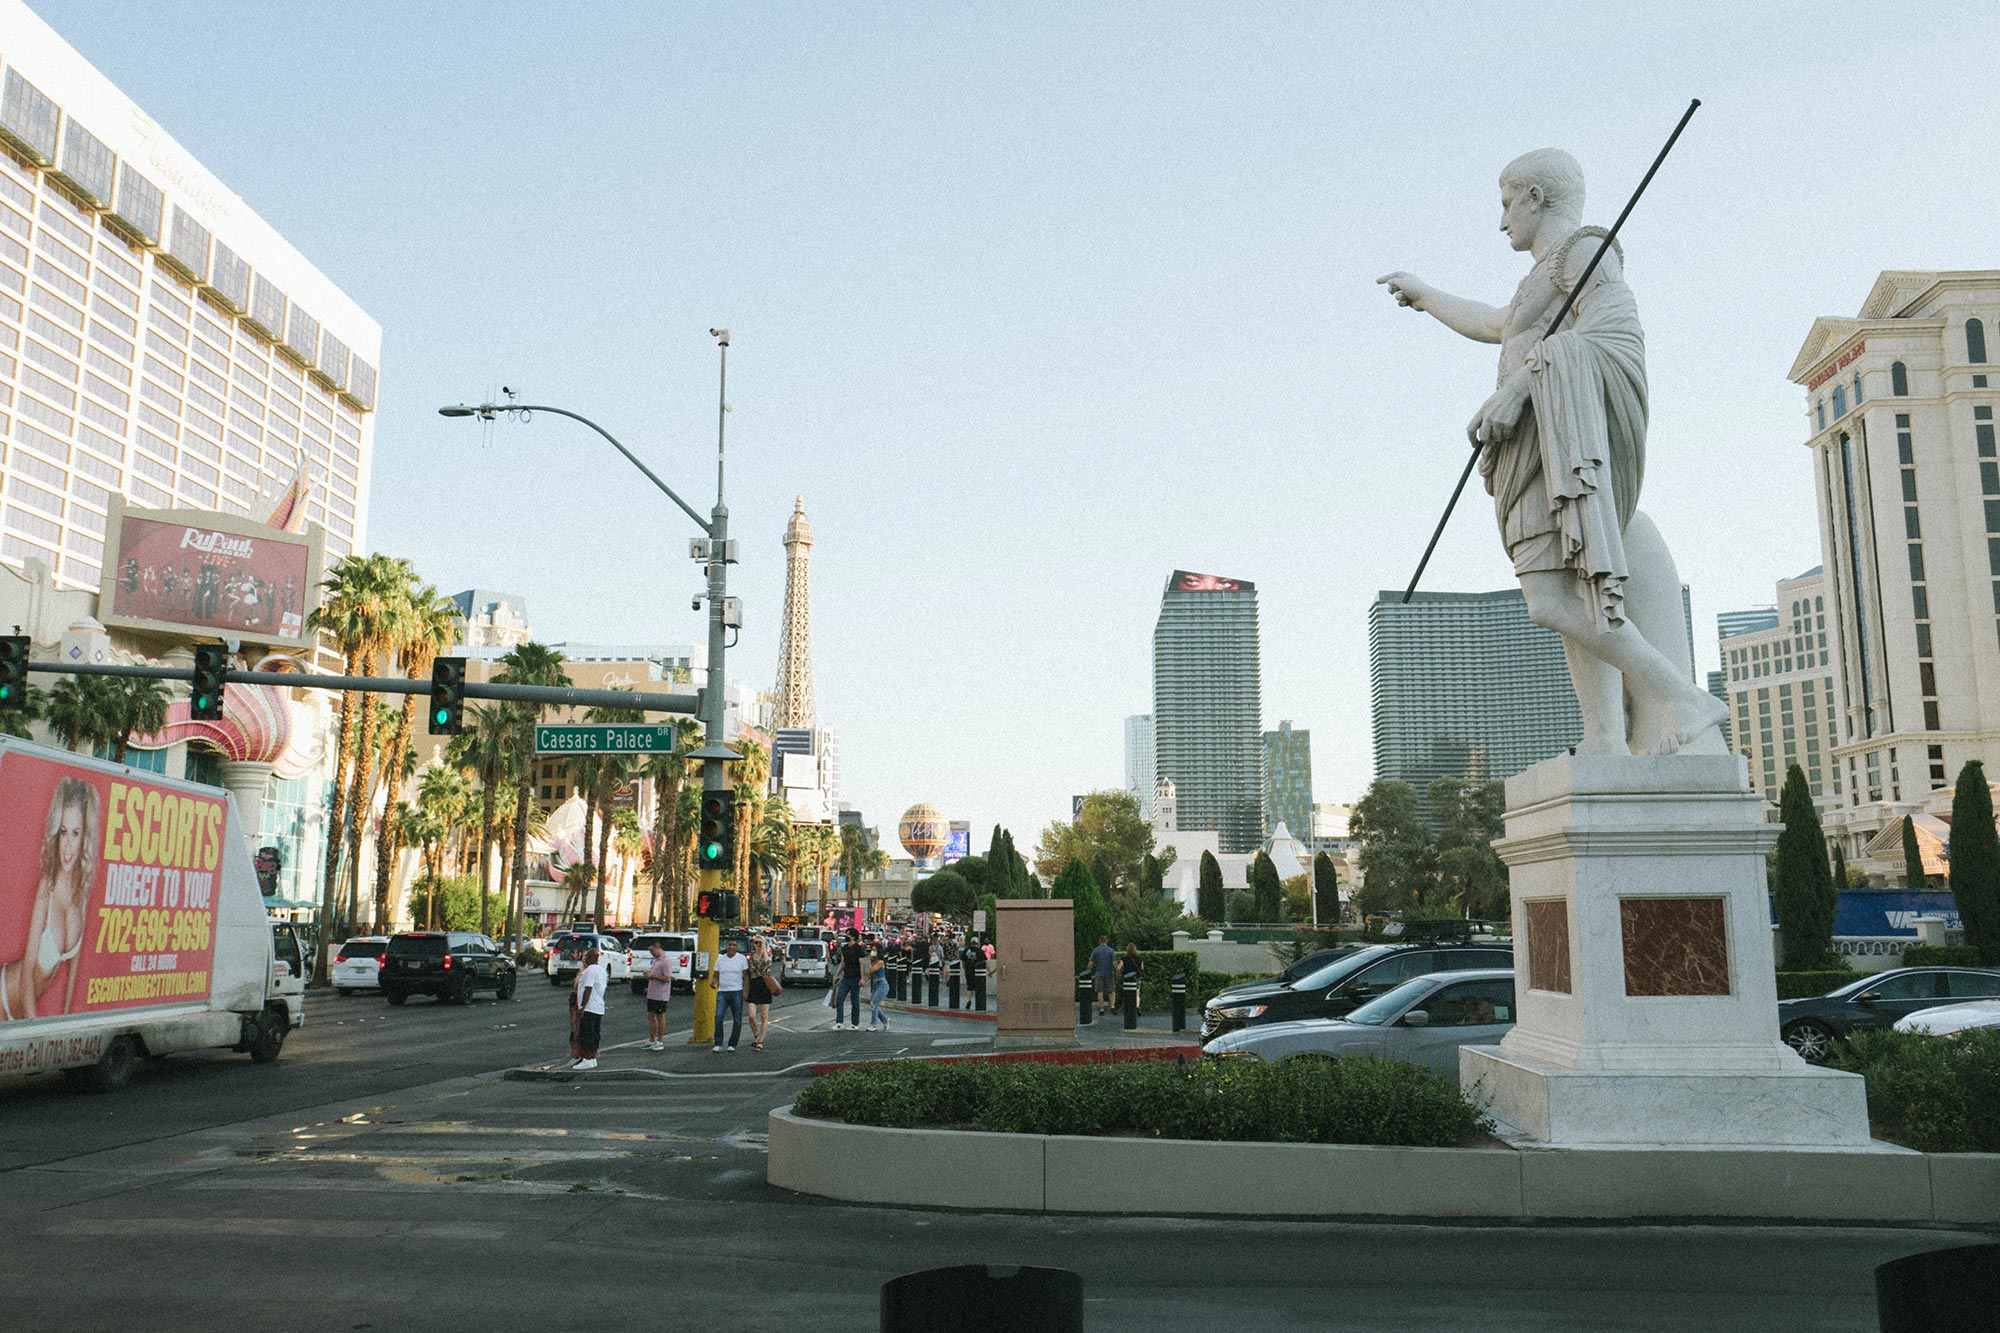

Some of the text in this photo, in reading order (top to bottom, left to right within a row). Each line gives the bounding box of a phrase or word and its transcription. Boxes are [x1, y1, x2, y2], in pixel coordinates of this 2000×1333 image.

[203, 553, 232, 568] LIVE
[541, 727, 669, 749] Caesars Palace DR
[103, 782, 222, 871] ESCORTS
[104, 863, 213, 909] DIRECT TO YOU!
[95, 907, 212, 953] 702-696-9696
